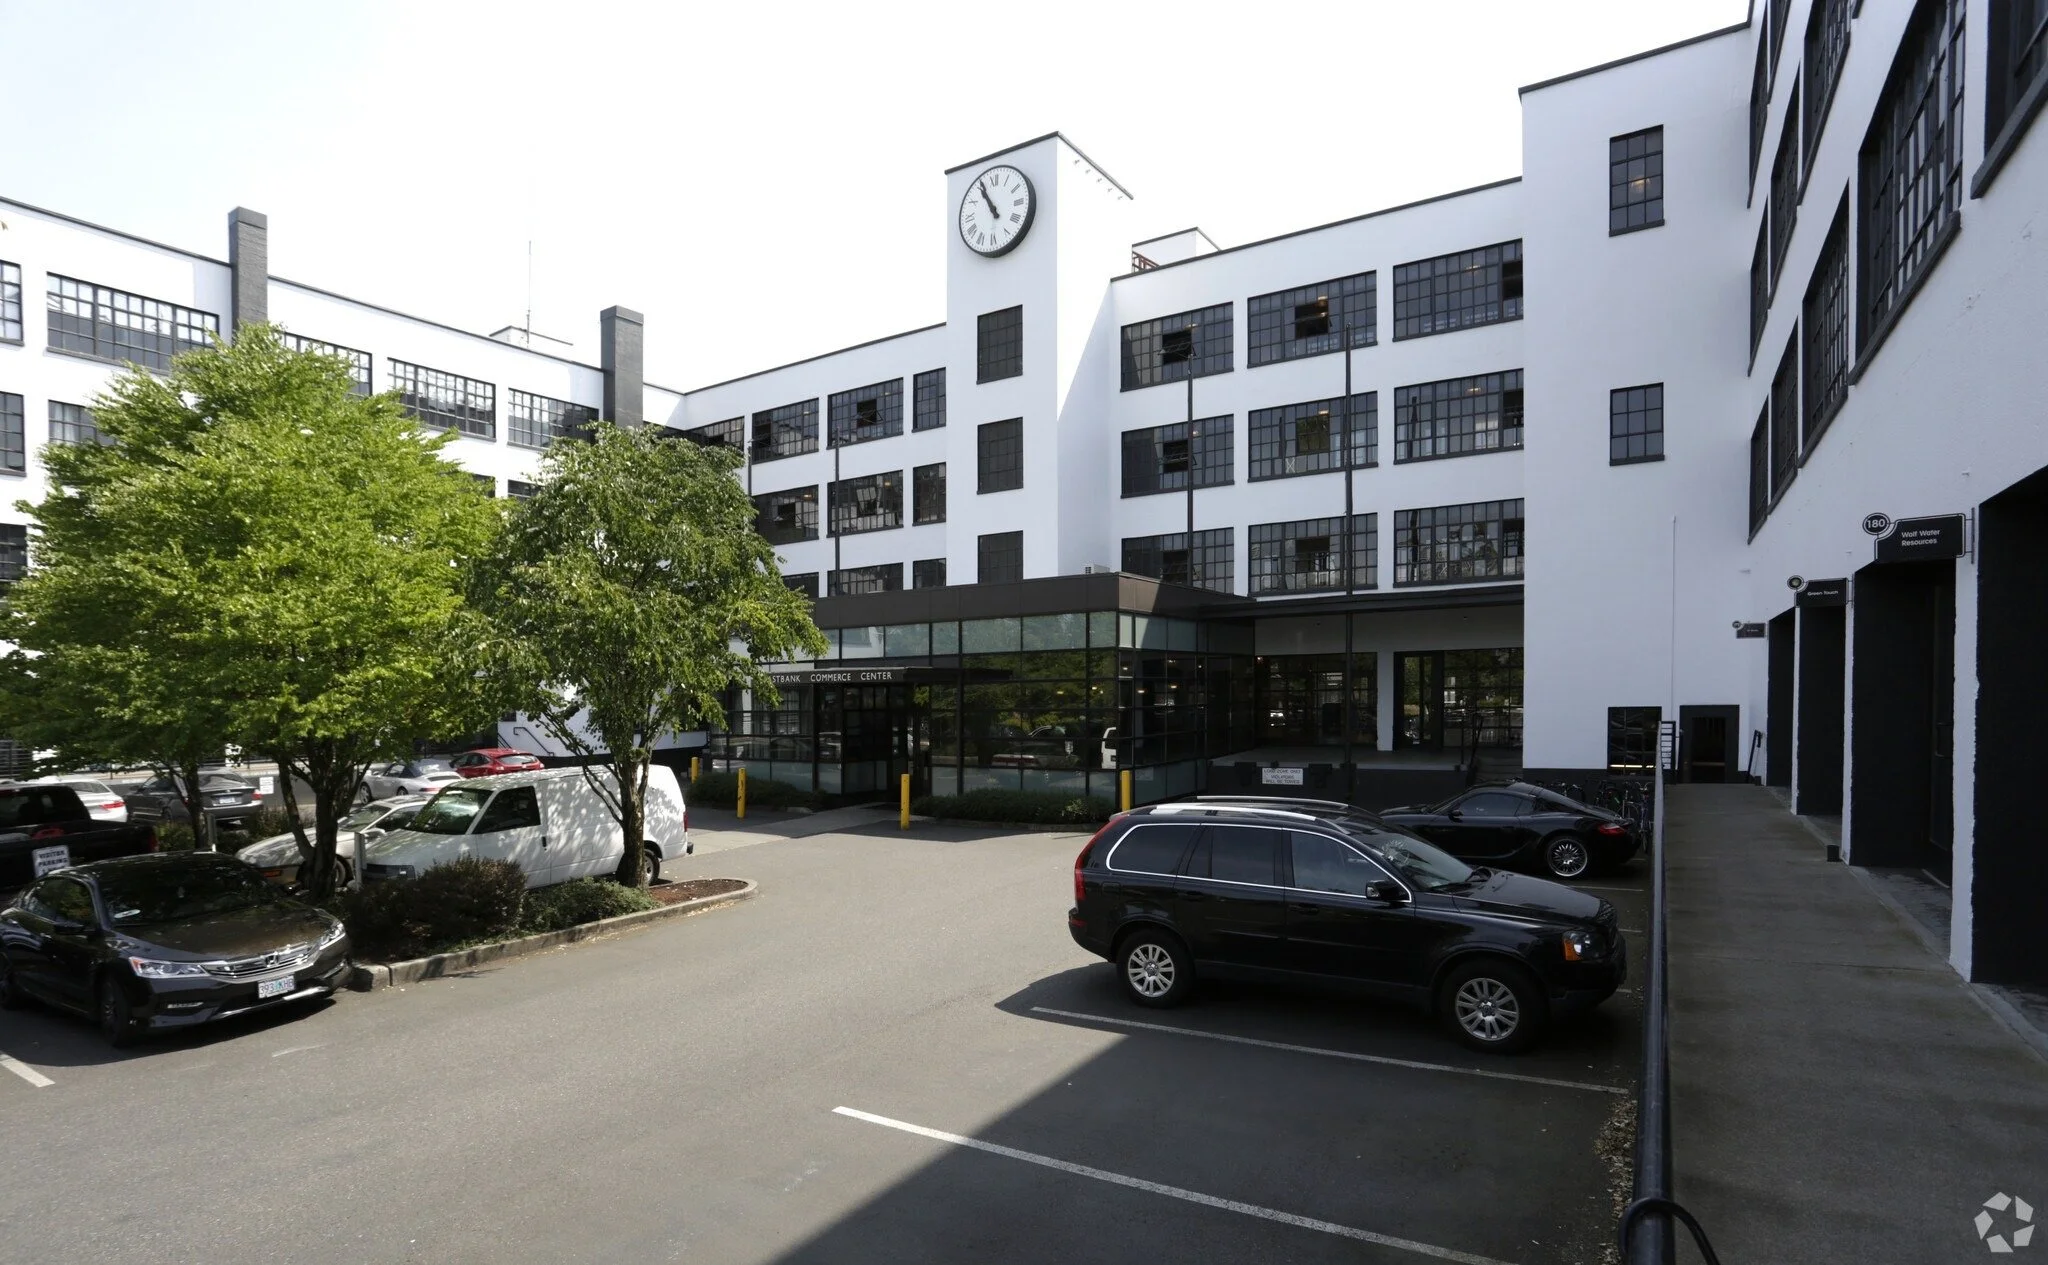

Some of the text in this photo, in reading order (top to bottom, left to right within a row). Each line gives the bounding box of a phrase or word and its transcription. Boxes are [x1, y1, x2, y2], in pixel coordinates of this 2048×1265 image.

[1866, 518, 1886, 529] 180
[1919, 529, 1941, 537] Water
[1901, 538, 1938, 547] Resources
[810, 673, 852, 682] COMMERCE
[860, 671, 893, 681] CENTER
[38, 858, 68, 866] PARKING
